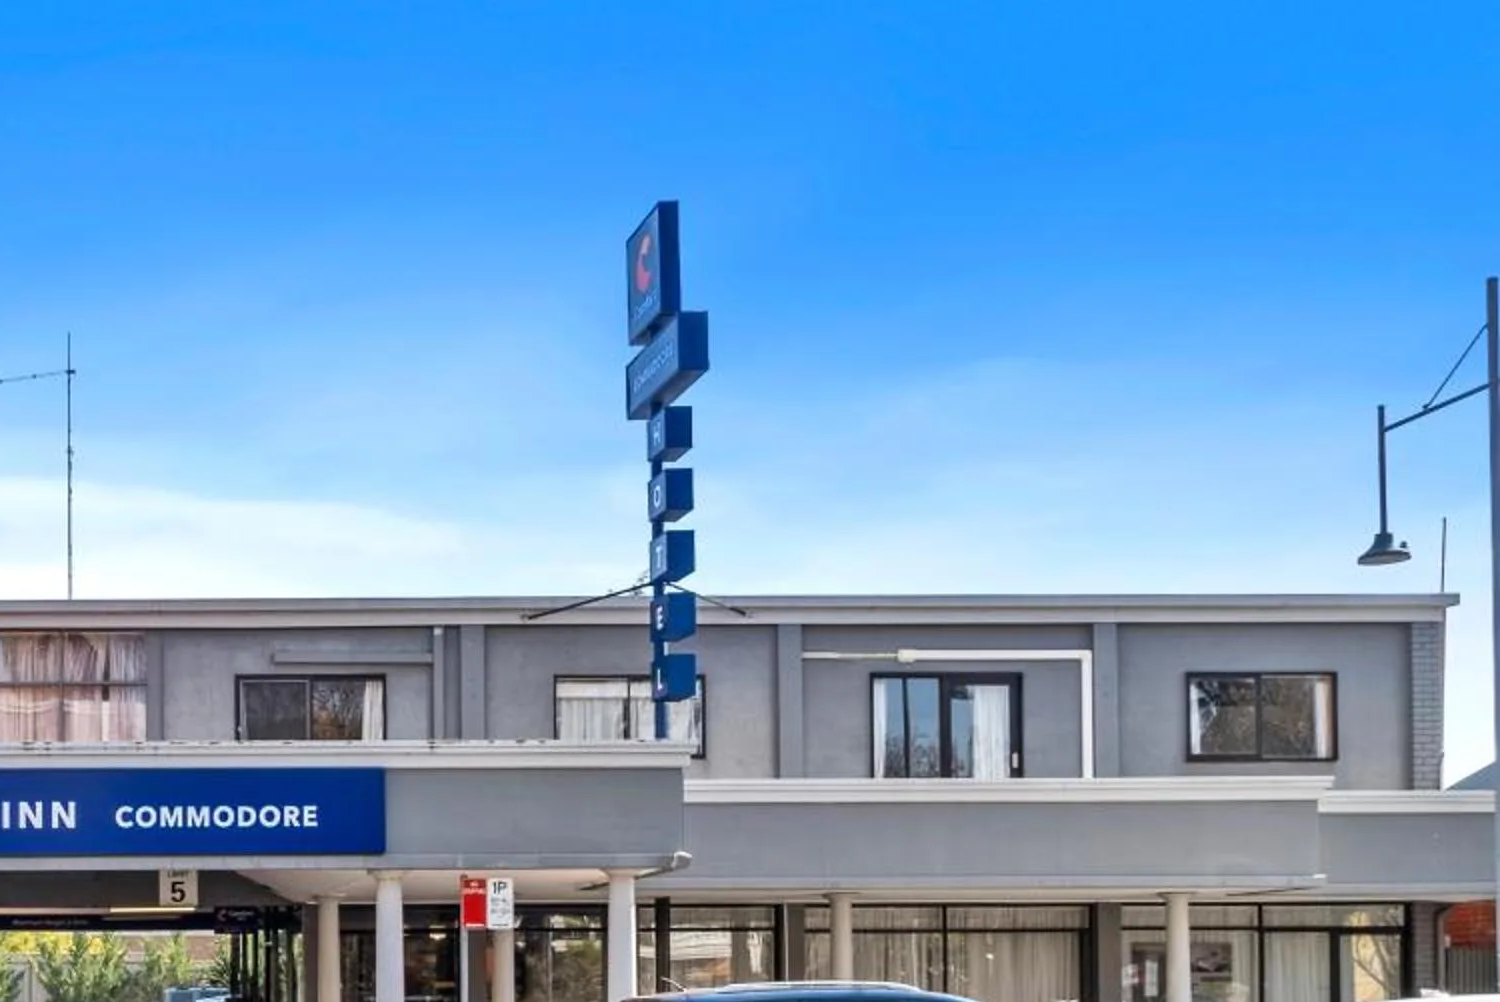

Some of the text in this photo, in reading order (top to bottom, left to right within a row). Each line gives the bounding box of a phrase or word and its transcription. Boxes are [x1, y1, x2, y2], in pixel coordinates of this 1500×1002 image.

[2, 801, 76, 829] INN
[115, 805, 318, 828] COMMODORE
[171, 881, 186, 902] 5
[493, 881, 508, 894] 1P
